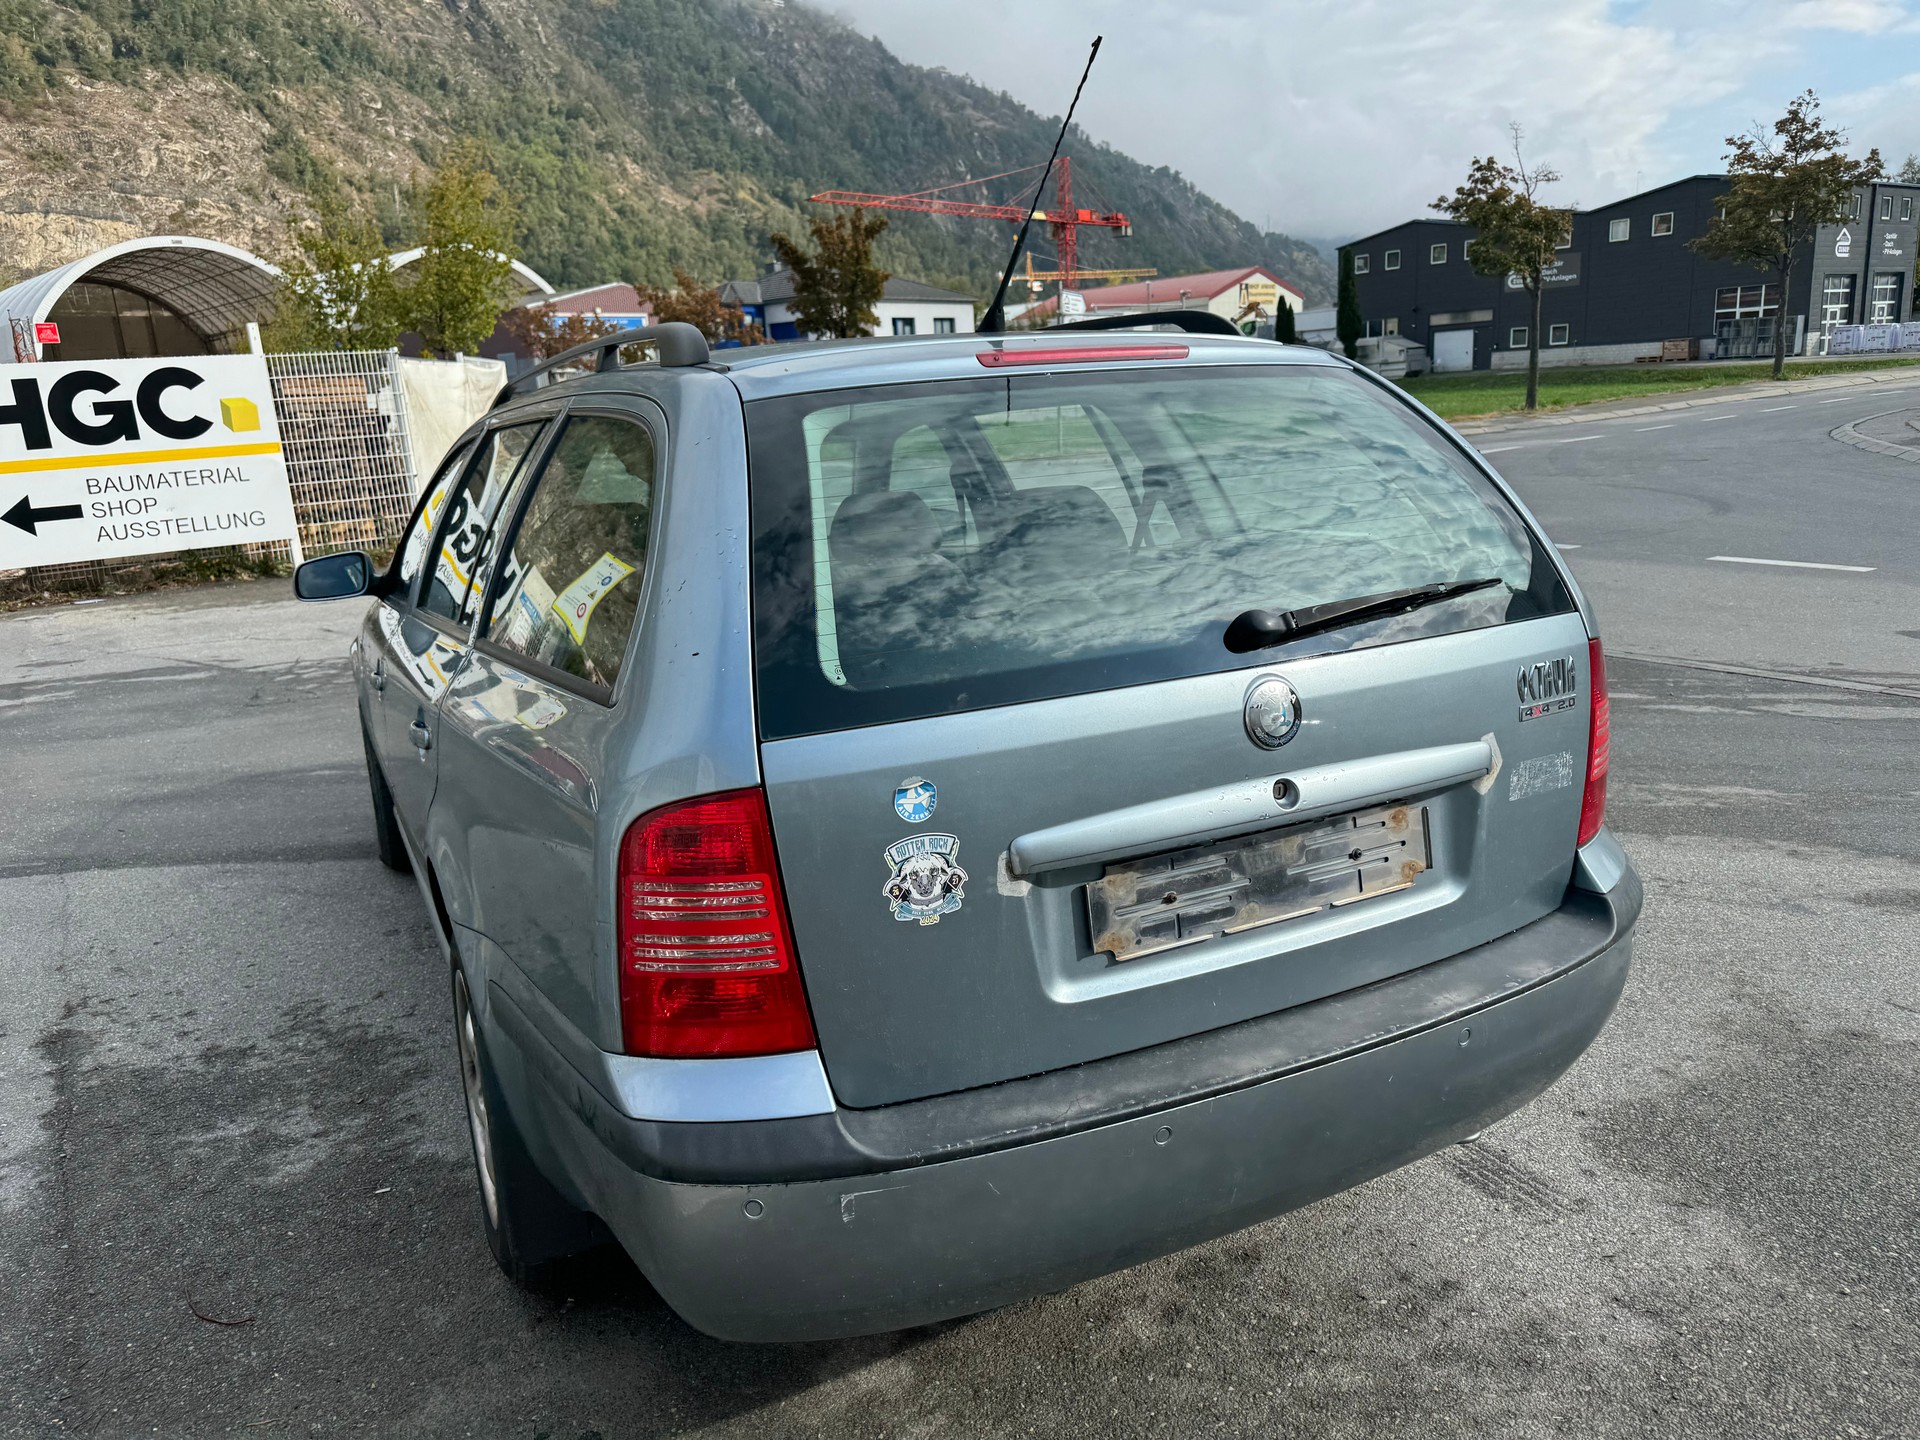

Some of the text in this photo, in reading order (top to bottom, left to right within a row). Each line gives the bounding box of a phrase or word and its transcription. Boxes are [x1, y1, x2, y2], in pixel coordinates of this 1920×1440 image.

[0, 366, 214, 450] HGC
[86, 466, 250, 495] BAUMATERIAL
[91, 497, 158, 519] SHOP
[97, 510, 266, 542] AUSSTELLUNG
[1516, 655, 1577, 704] OCTAVIA
[898, 806, 910, 818] AIR
[894, 837, 949, 859] ROTTEN ROCK
[920, 914, 939, 925] 2024
